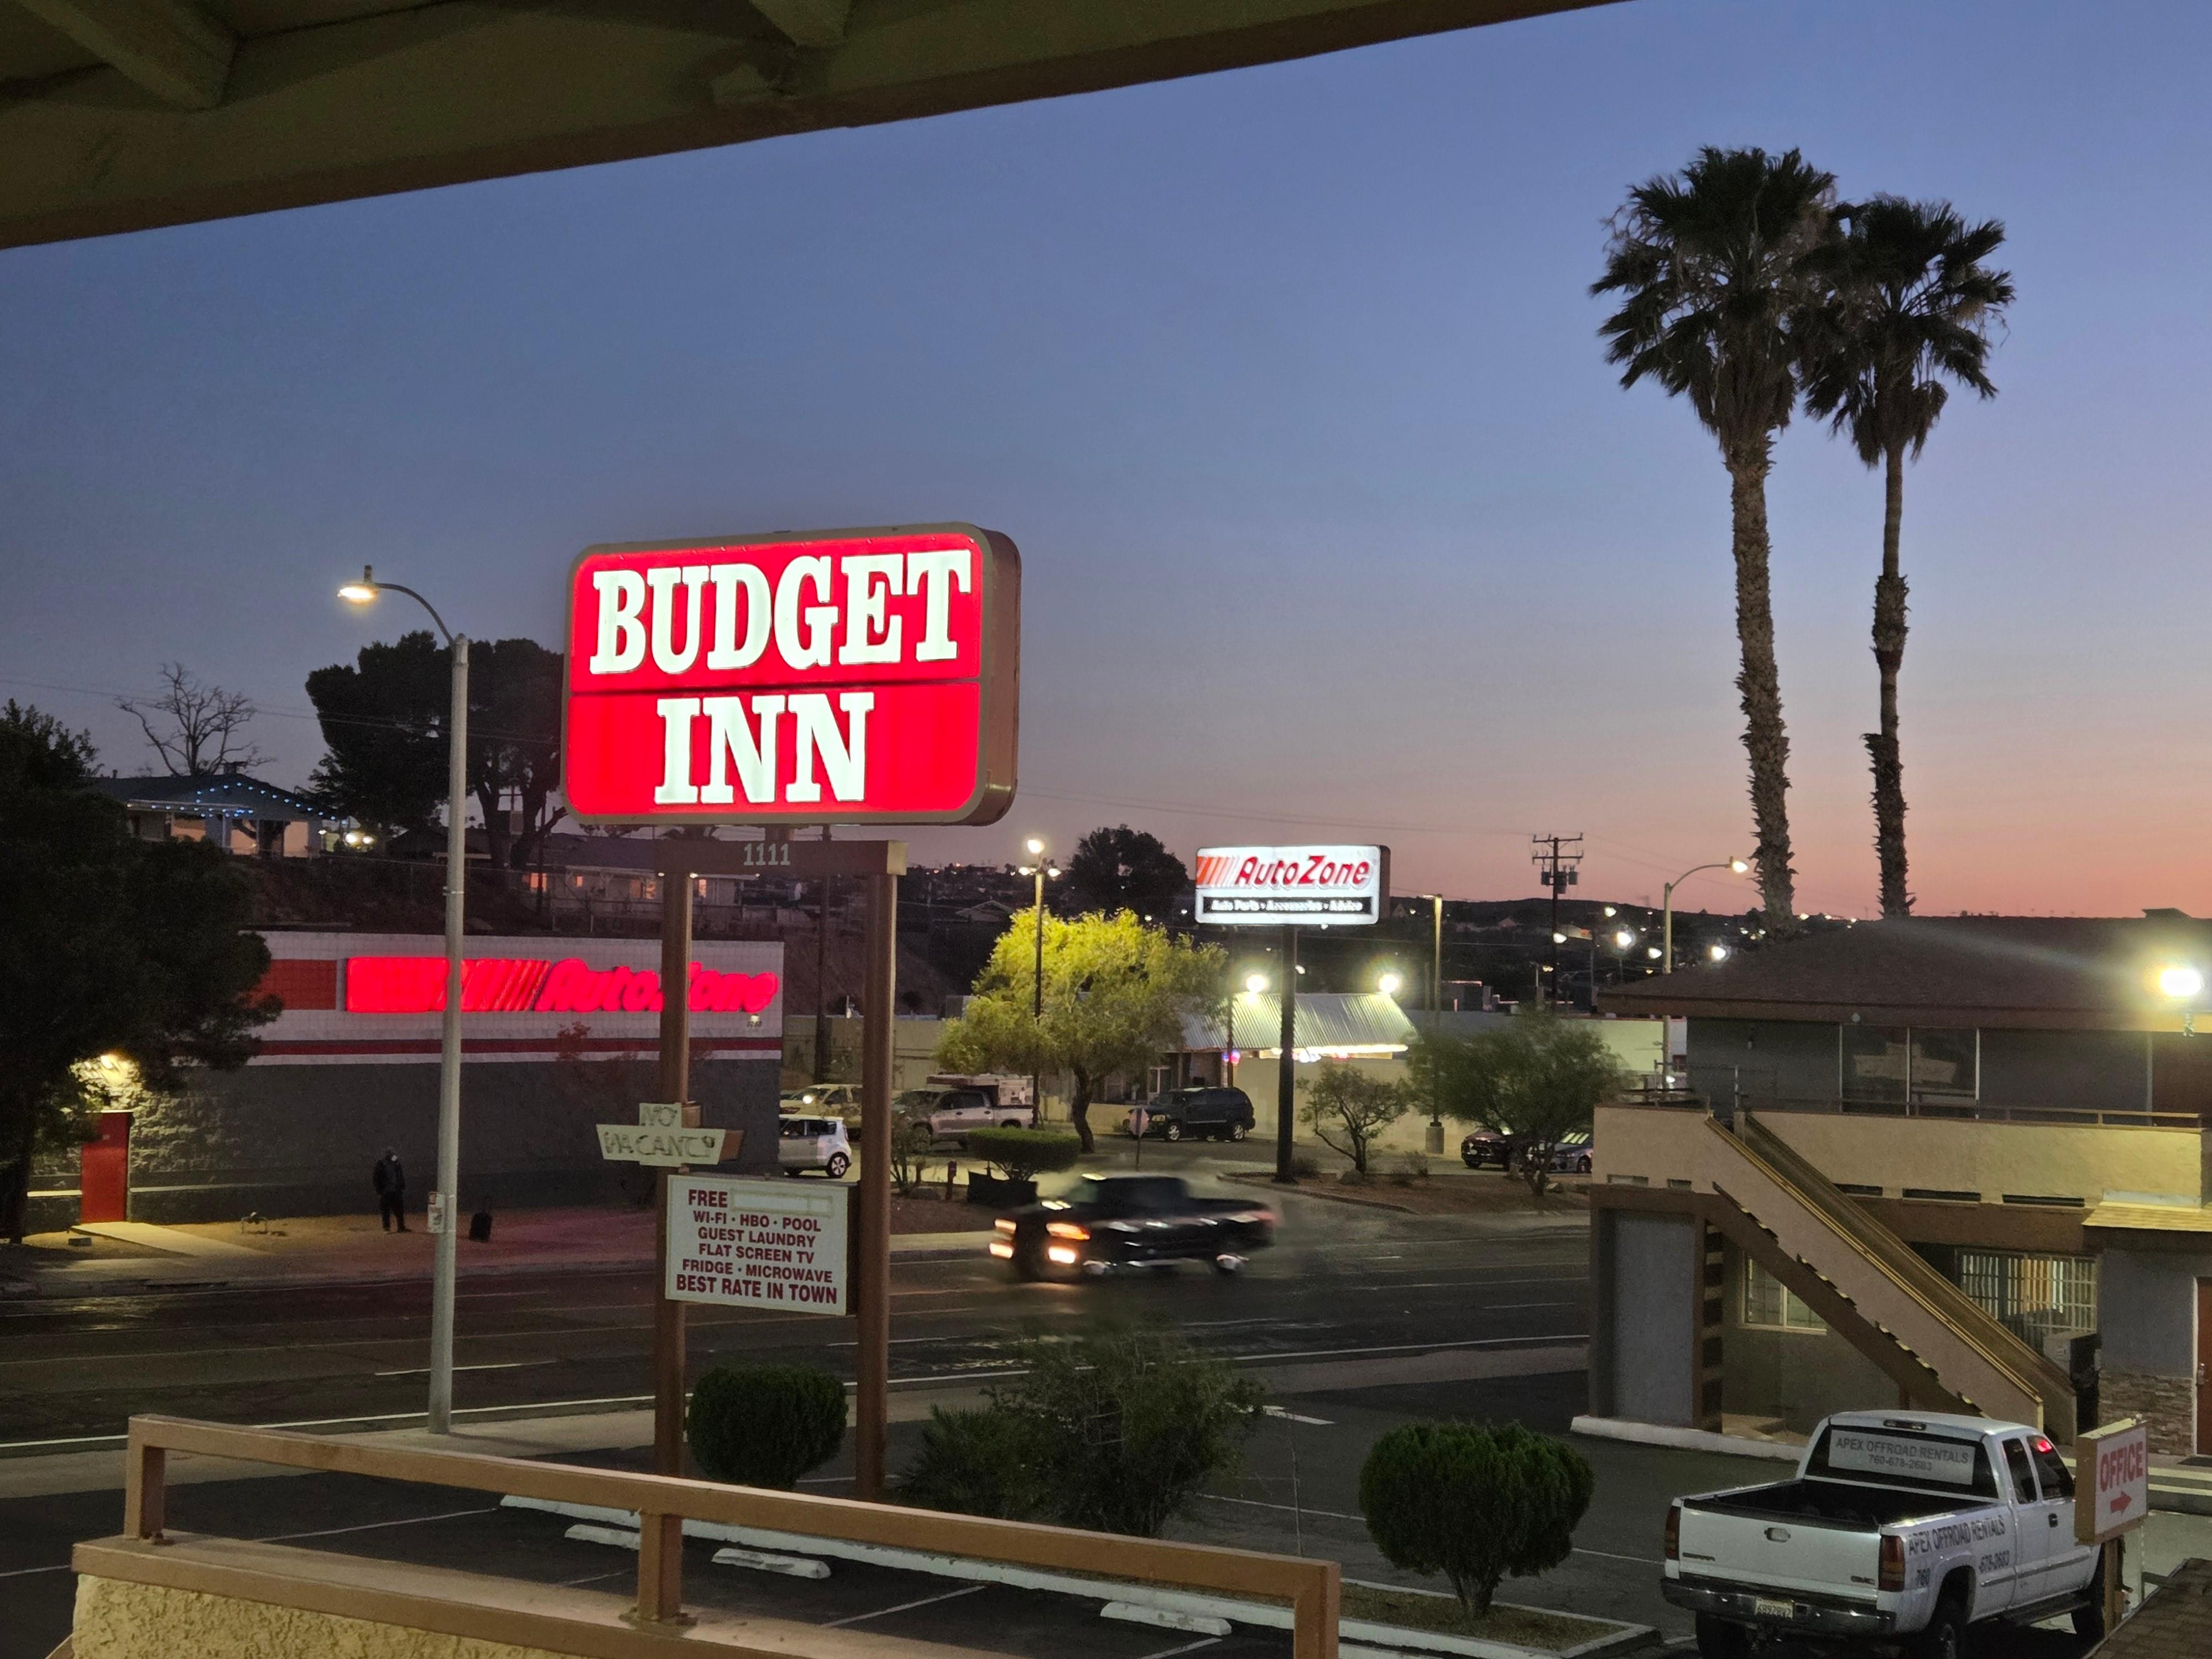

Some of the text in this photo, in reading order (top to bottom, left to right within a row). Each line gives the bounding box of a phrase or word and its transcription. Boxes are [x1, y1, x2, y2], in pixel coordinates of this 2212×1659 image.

[589, 550, 972, 675] BUDGET
[654, 691, 874, 805] INN
[744, 843, 790, 866] 1111
[1235, 855, 1370, 885] AutoZone
[534, 958, 779, 1013] Autoone
[640, 1106, 677, 1126] NO
[688, 1189, 728, 1208] FREE
[740, 1214, 770, 1228] HBO
[782, 1217, 821, 1232] POOL
[698, 1227, 815, 1248] GUEST LAUNDRY
[699, 1243, 814, 1264] FLAT SCREEN TV
[682, 1259, 832, 1283] FRIDGE MICROWAVE
[676, 1274, 837, 1304] BEST RATE IN TOWN
[1836, 1437, 1969, 1464] APEX OFFROAD RENTALS
[2100, 1441, 2143, 1492] OFFICE
[1909, 1514, 2006, 1555] APEX OFFROAD RENTALS
